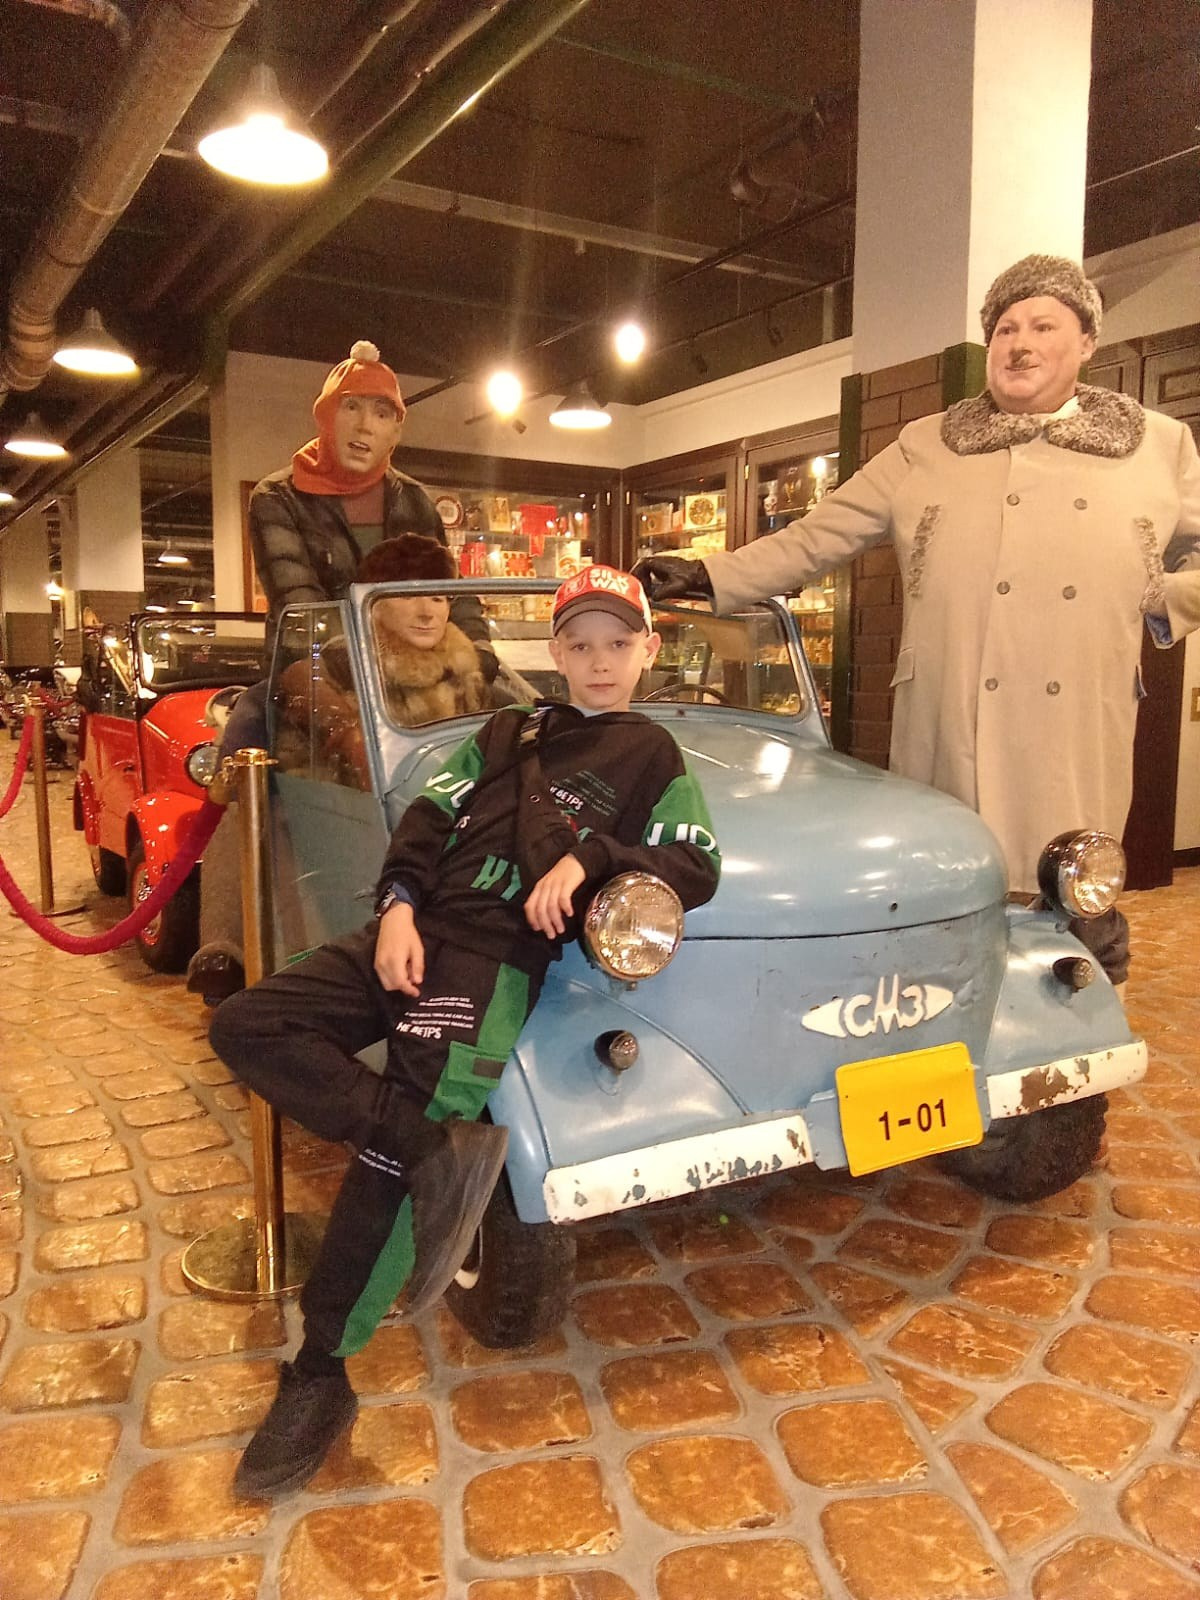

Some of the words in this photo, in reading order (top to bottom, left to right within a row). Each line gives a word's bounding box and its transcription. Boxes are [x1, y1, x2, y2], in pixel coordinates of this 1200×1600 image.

[590, 568, 629, 584] SILK
[590, 578, 629, 595] WAY
[878, 1099, 946, 1141] 1-01
